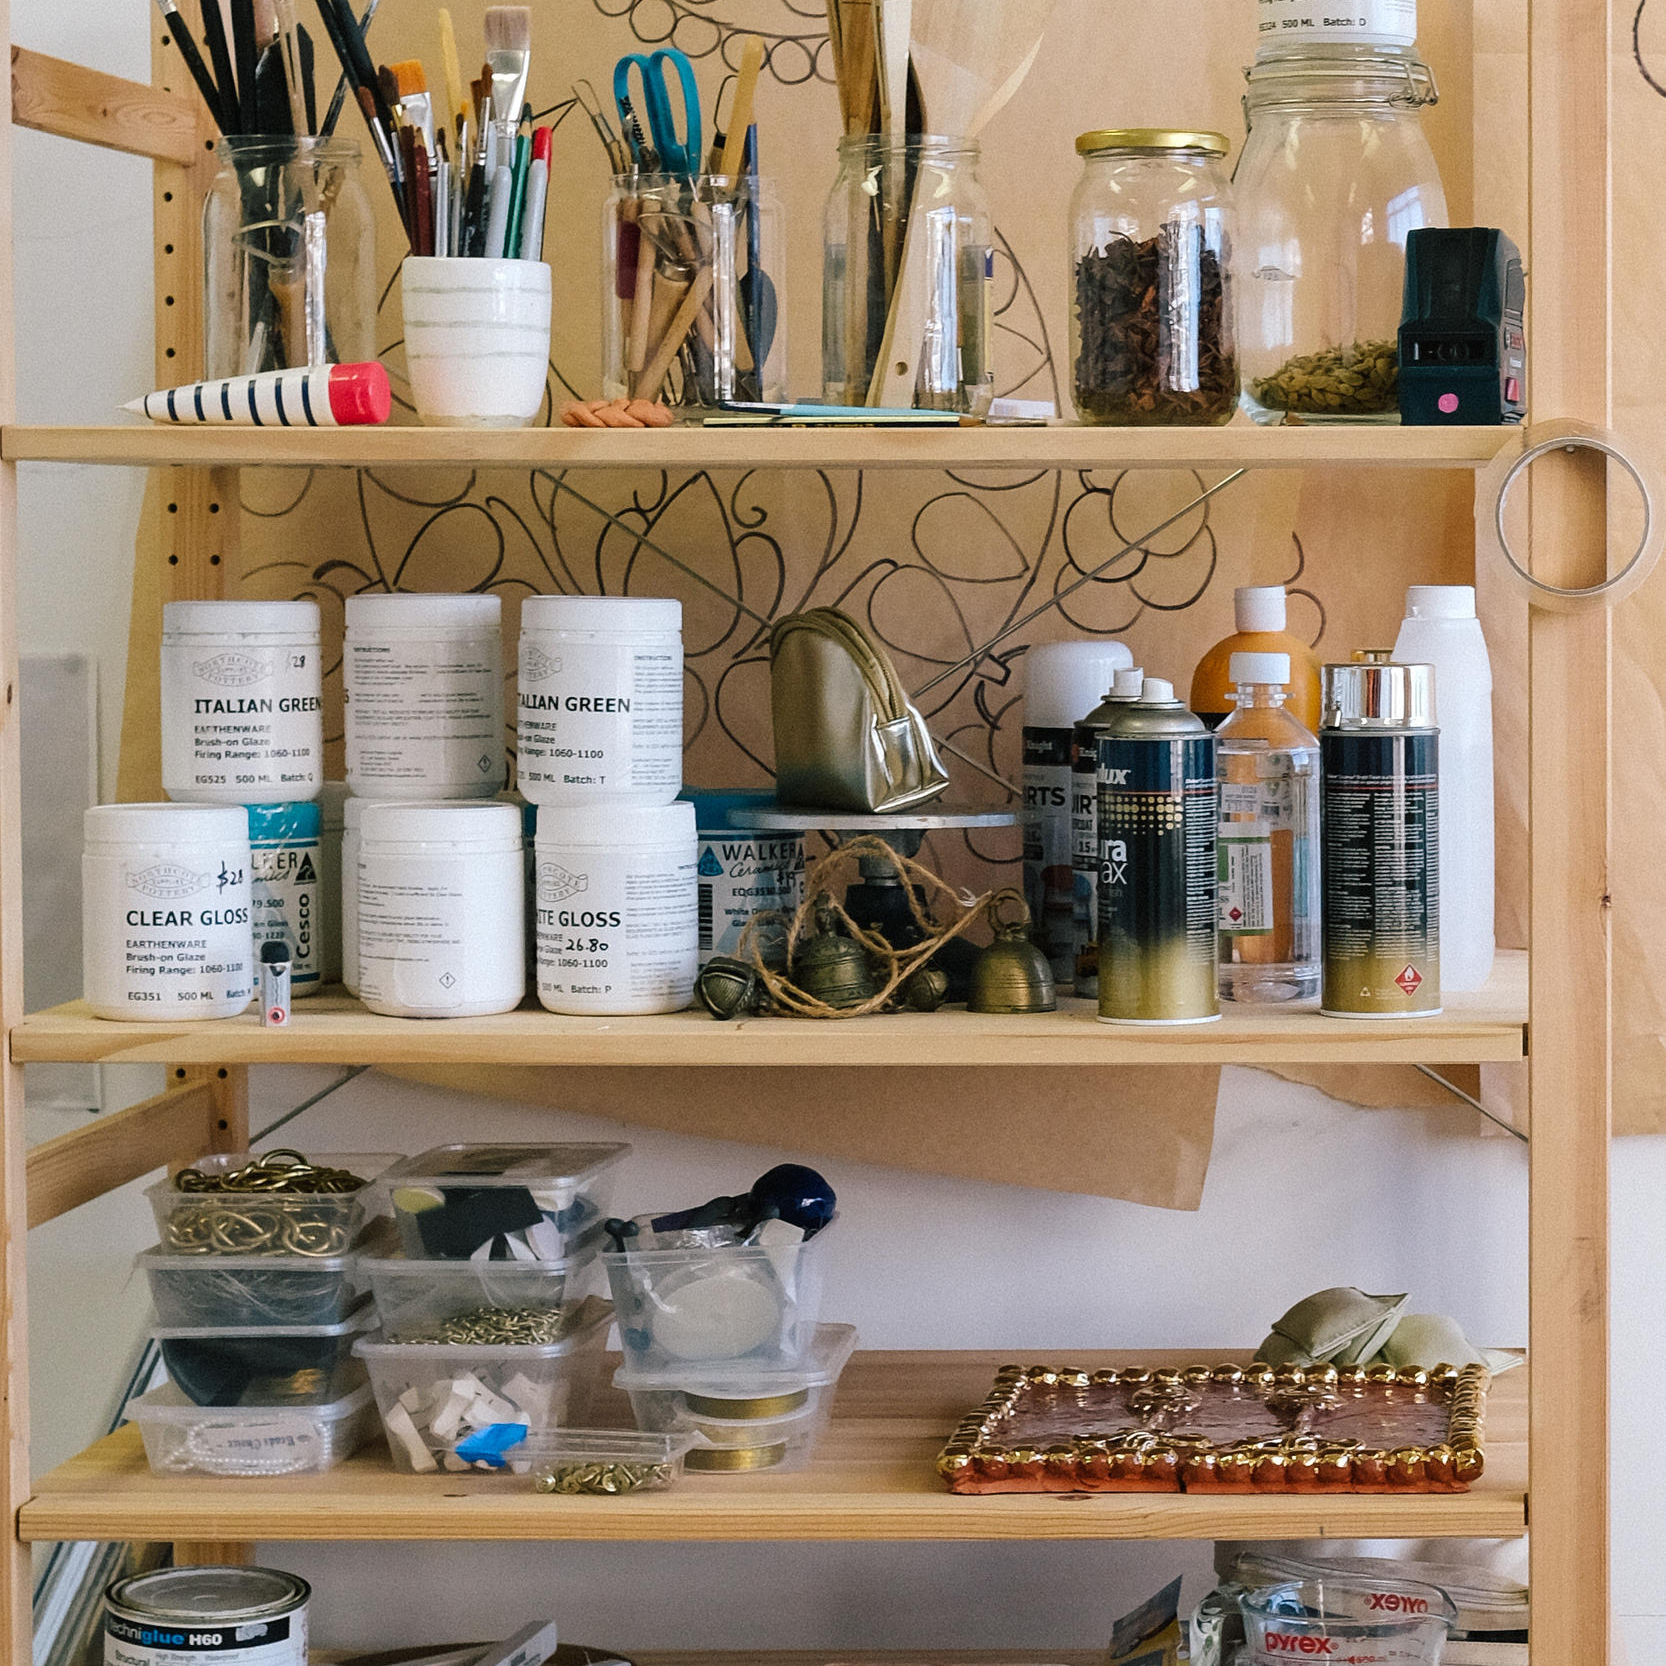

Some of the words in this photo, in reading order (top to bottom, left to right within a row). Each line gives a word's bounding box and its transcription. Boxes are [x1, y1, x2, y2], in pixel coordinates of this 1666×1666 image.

[1282, 19, 1298, 29] 500
[1323, 17, 1356, 27] Batch:
[194, 698, 273, 714] ITALIAN
[565, 696, 631, 713] GREEN
[194, 737, 239, 747] Brush-on
[241, 737, 271, 747] Glaze
[533, 735, 556, 745] Glaze
[194, 750, 222, 761] Firing
[224, 749, 261, 760] Range:
[549, 749, 604, 760] 1060-1100
[235, 775, 255, 784] 500
[258, 774, 273, 784] ML
[563, 775, 597, 785] Batch:
[599, 776, 606, 785] T
[1102, 861, 1128, 885] ax
[126, 910, 193, 927] CLEAR
[200, 908, 249, 926] GLOSS
[537, 909, 554, 926] ITE
[559, 911, 621, 928] GLOSS
[296, 893, 311, 959] Cesco
[126, 940, 207, 949] EARTHENWARE
[565, 938, 609, 953] 26.80
[126, 953, 174, 963] Brush-on
[177, 953, 206, 962] Glaze
[557, 958, 608, 968] 1060-1100
[126, 966, 155, 977] Firing
[159, 966, 196, 976] Range:
[571, 985, 601, 994] Batch:
[128, 992, 162, 1001] EG351
[178, 992, 198, 1001] 500
[200, 991, 214, 1001] ML
[189, 1633, 223, 1646] H60
